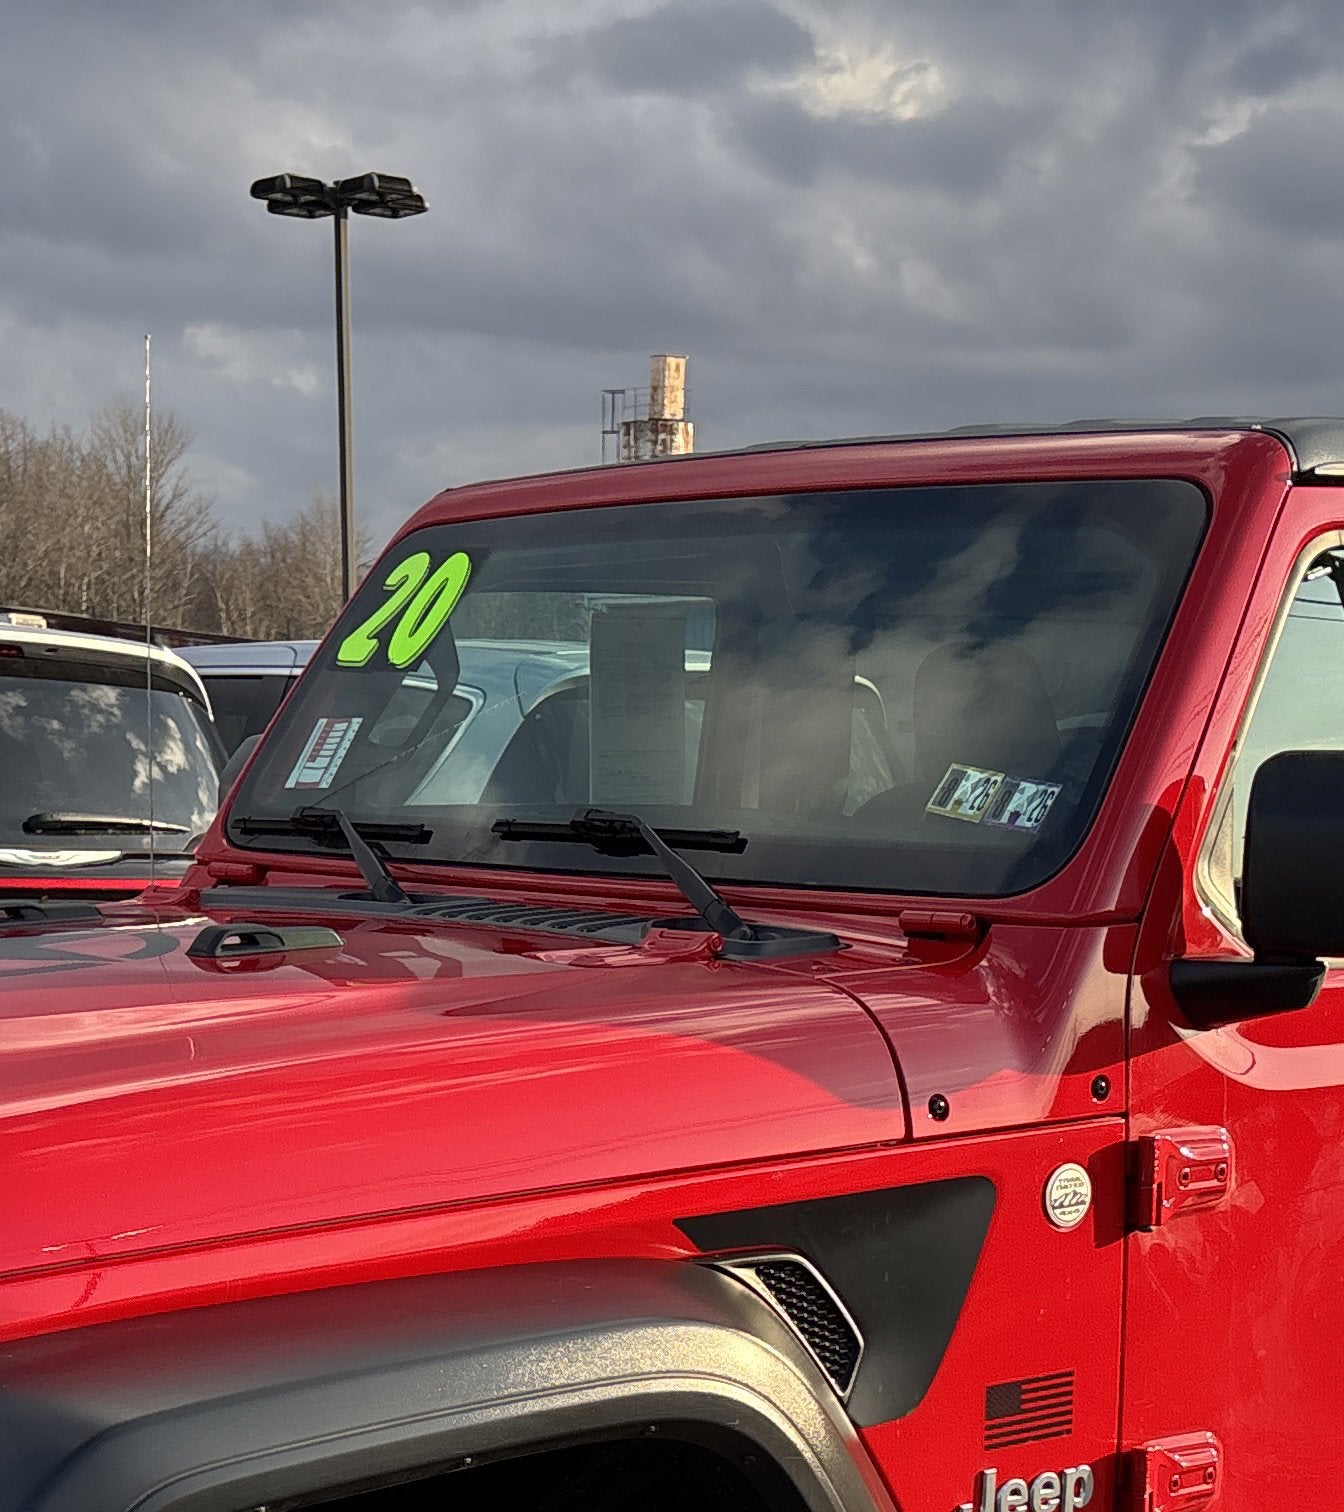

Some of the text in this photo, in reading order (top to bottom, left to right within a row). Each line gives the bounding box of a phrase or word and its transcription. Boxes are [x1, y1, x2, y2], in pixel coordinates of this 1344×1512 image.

[336, 551, 472, 669] 20
[968, 777, 999, 812] 26
[1026, 789, 1056, 823] 26
